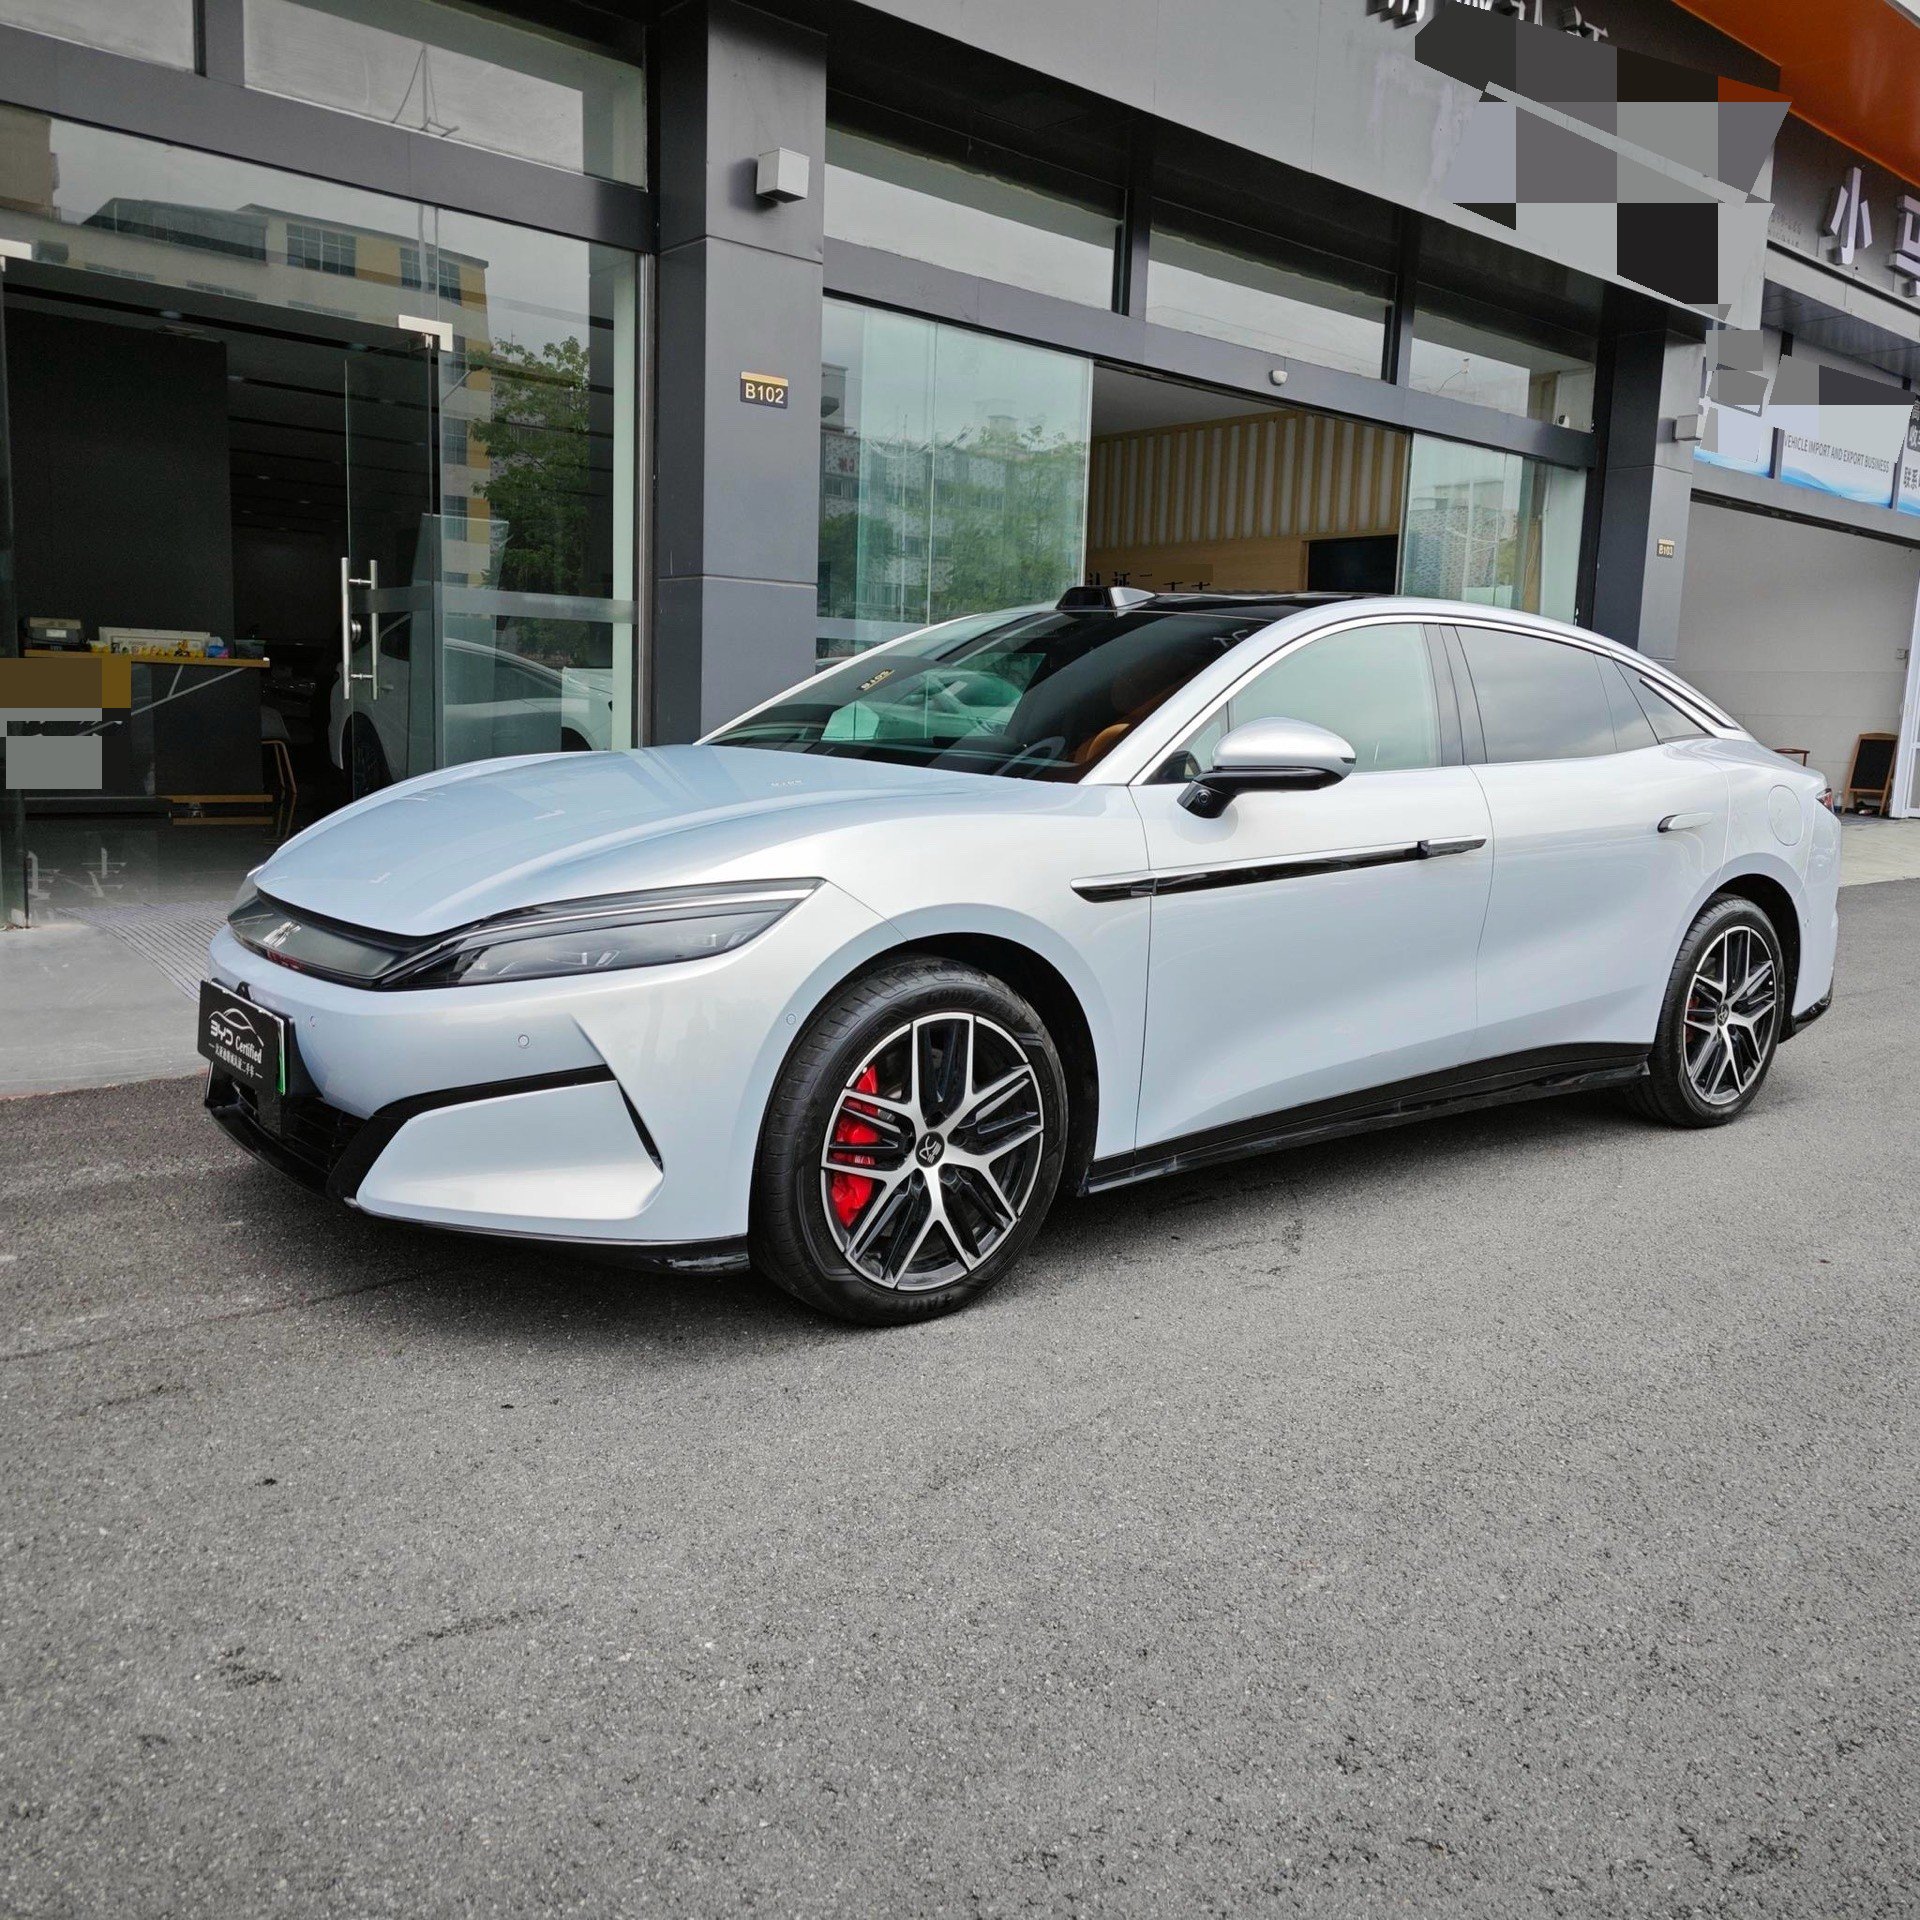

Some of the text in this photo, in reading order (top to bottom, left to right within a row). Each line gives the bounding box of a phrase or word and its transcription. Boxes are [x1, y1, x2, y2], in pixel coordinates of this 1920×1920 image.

[745, 382, 784, 404] B102
[1808, 440, 1831, 457] IMPORT
[1831, 446, 1842, 461] AND
[1843, 449, 1865, 466] EXPORT
[1864, 455, 1889, 474] BUSINESS
[1903, 466, 1920, 490] 联系
[210, 1019, 263, 1064] BYD Certified
